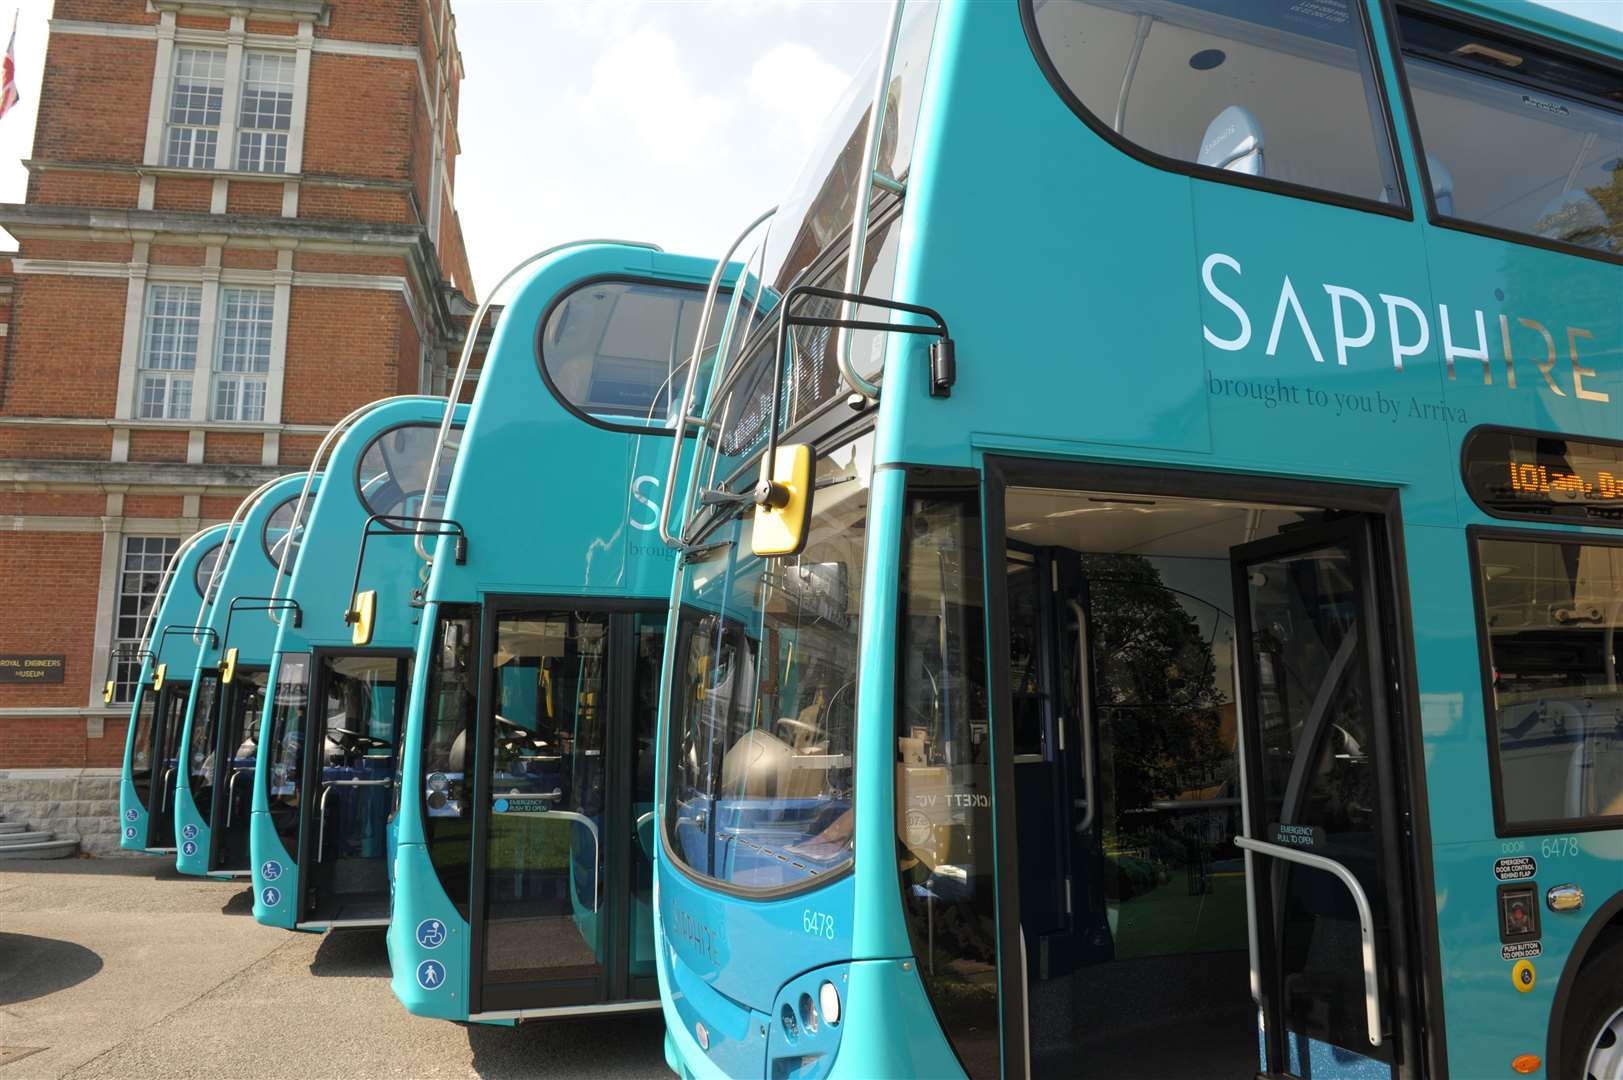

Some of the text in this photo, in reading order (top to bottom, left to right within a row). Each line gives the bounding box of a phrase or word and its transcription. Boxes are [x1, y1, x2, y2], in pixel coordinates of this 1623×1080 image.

[1202, 253, 1609, 402] SAPPHIRE
[1208, 370, 1467, 424] brought to you by Arriva
[630, 475, 662, 531] S
[24, 659, 61, 667] ENGINEERS
[1280, 824, 1313, 836] EMERGENCY
[1542, 837, 1579, 858] 6478
[1500, 858, 1529, 866] EMERGENCY
[1511, 863, 1535, 872] CONTROL
[1520, 870, 1532, 878] FLAP
[803, 908, 834, 940] 6478
